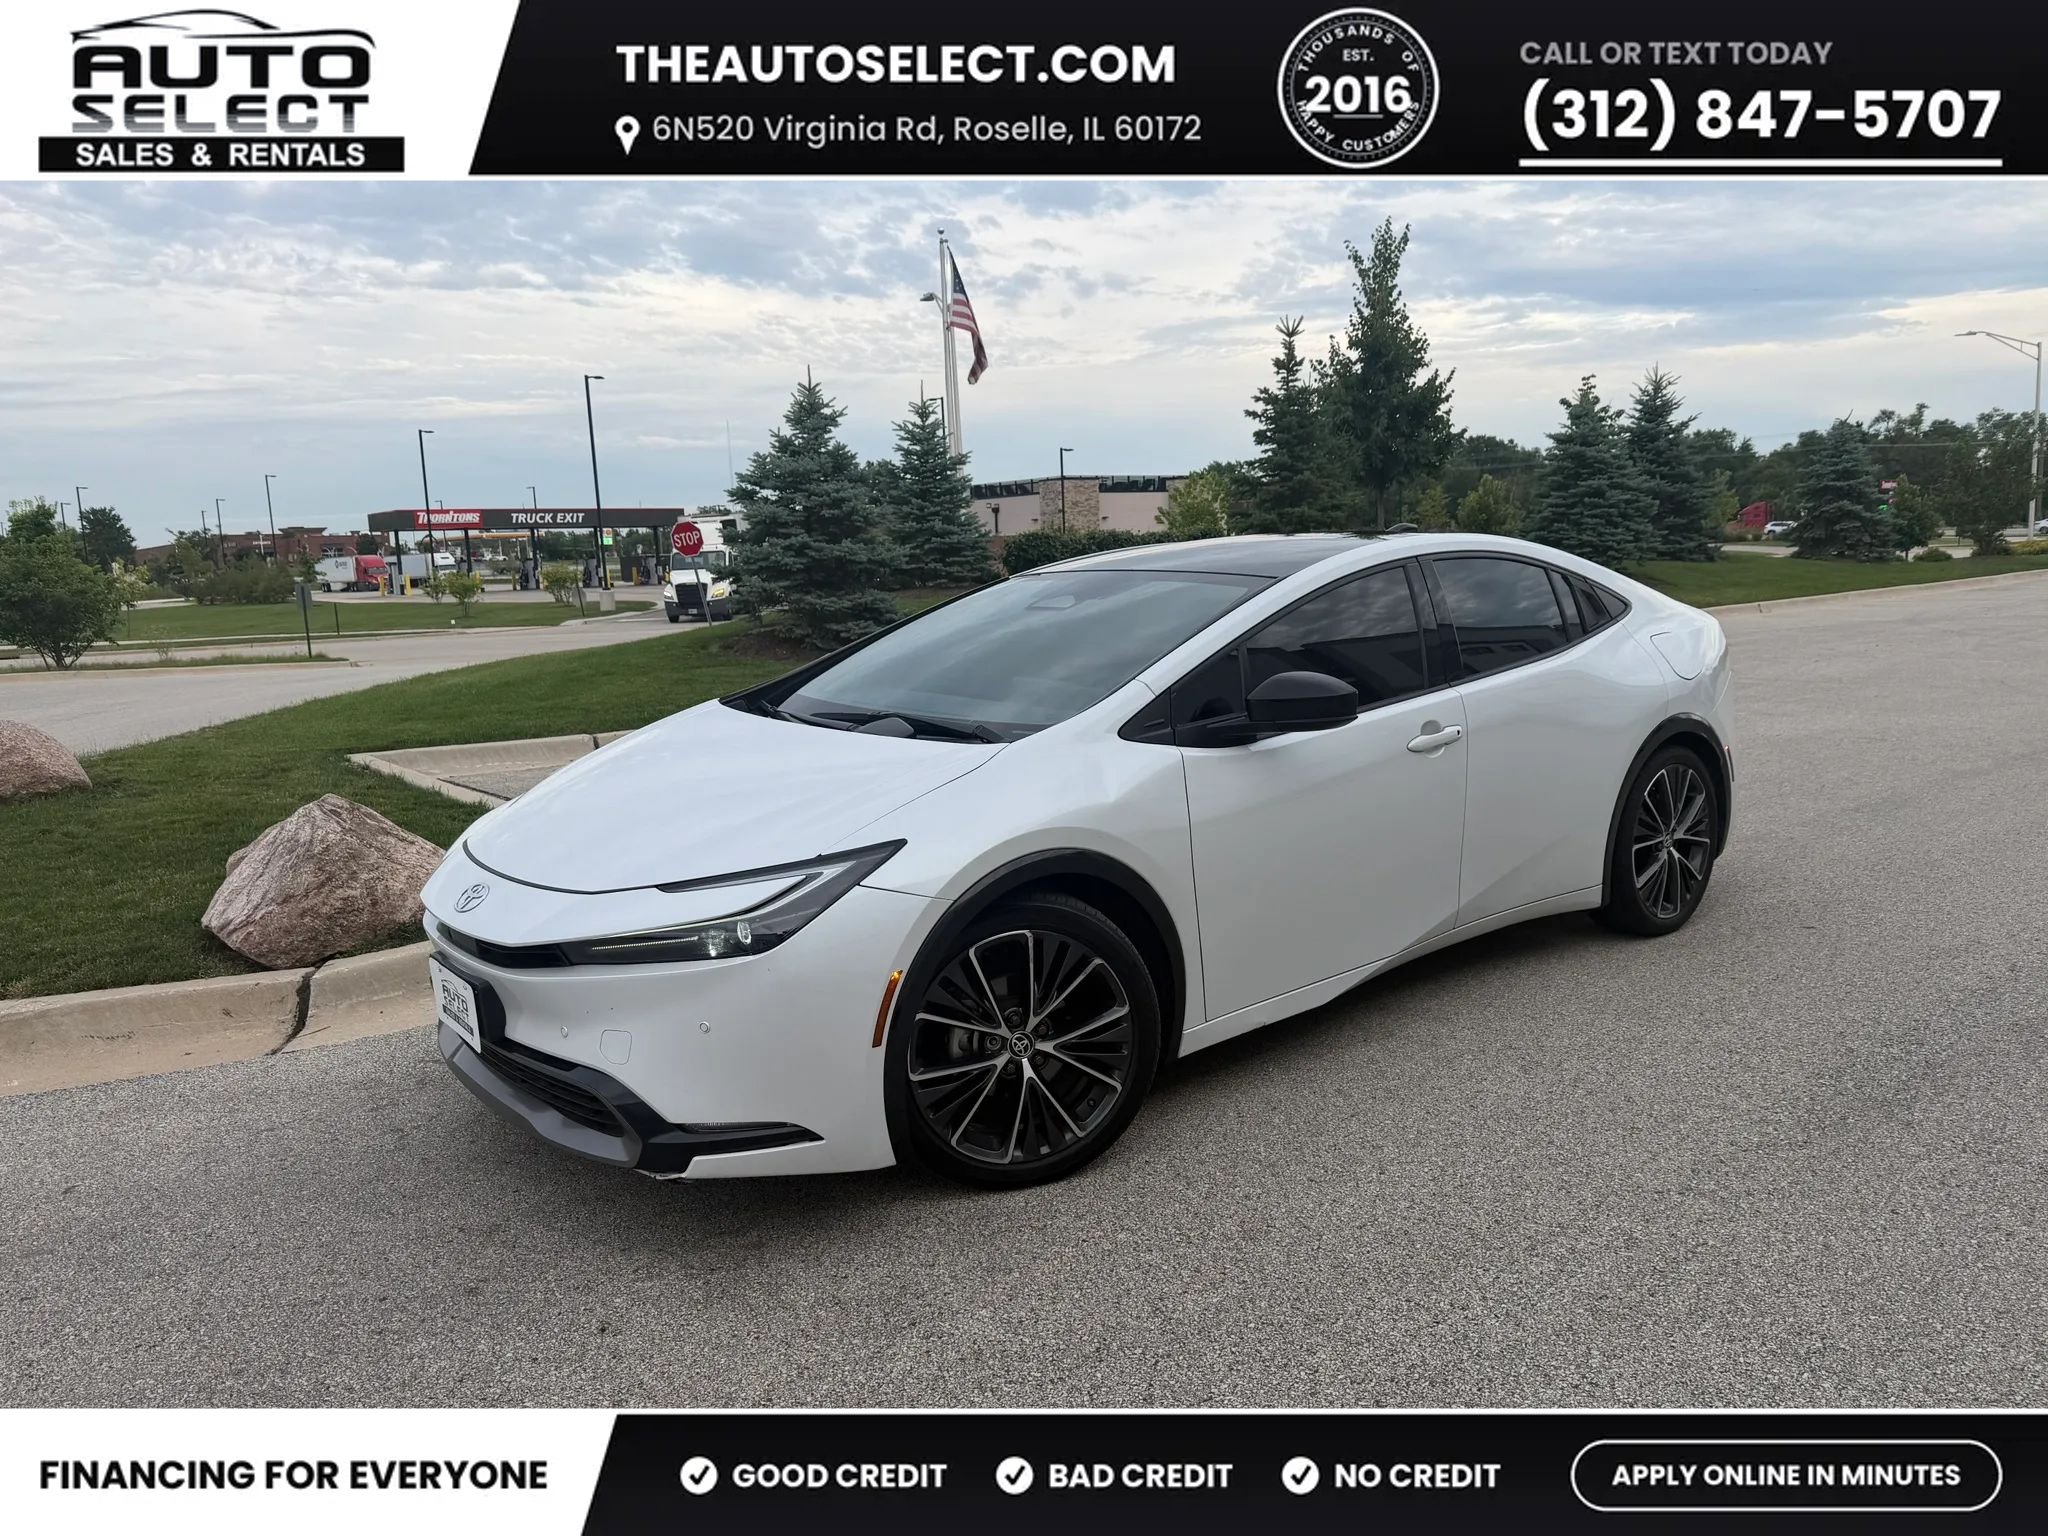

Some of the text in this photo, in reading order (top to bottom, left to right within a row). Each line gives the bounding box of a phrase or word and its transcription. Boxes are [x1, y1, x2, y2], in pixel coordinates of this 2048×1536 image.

[511, 512, 585, 524] TRUCK EXIT
[673, 530, 700, 547] STOP
[442, 984, 469, 1012] AUTO
